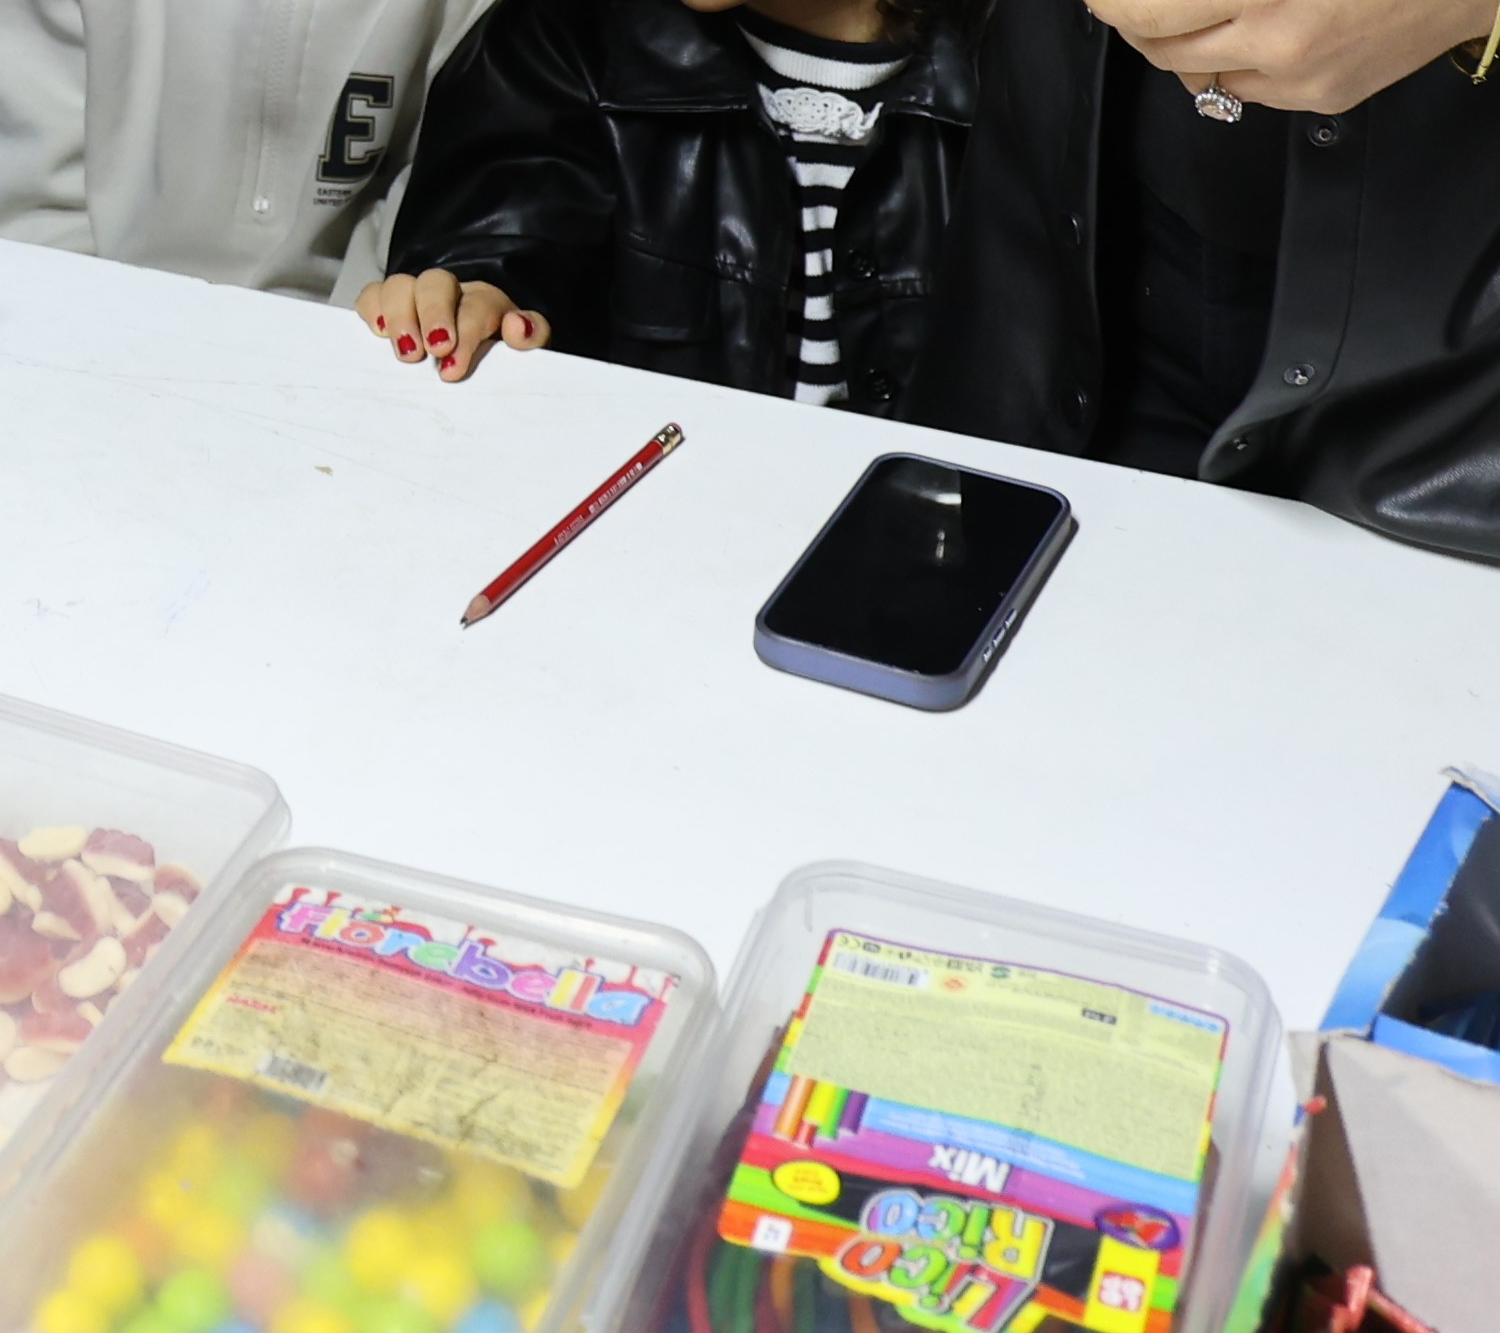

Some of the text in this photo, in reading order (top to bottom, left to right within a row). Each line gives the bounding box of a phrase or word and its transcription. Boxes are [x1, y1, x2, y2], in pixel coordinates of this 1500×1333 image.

[928, 1144, 1011, 1194] Mix
[861, 1188, 1056, 1283] Rico
[833, 1235, 1042, 1333] Lico
